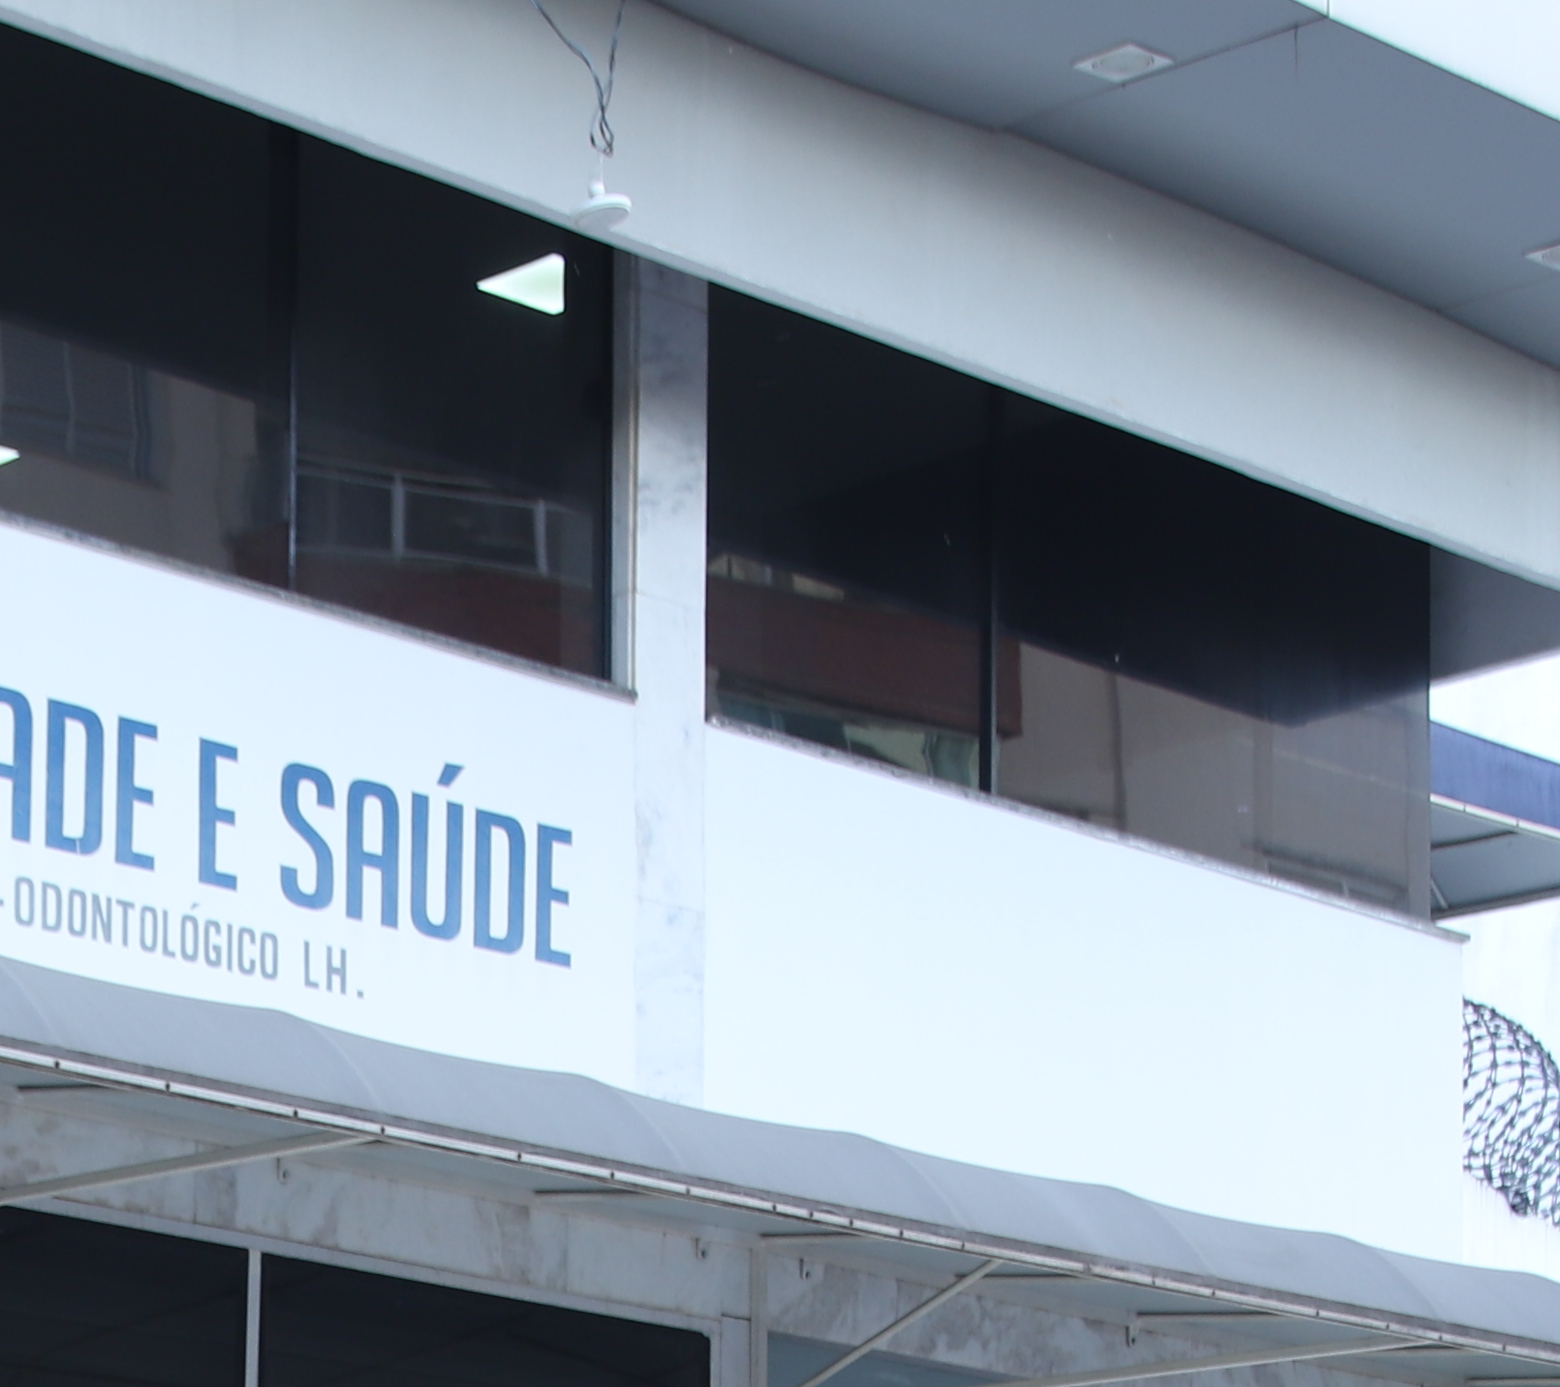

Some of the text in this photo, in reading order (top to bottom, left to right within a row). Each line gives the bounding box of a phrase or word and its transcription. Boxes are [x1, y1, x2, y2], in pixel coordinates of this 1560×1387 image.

[198, 737, 238, 891] E
[279, 762, 573, 969] SAÚDE
[304, 940, 365, 999] LH.
